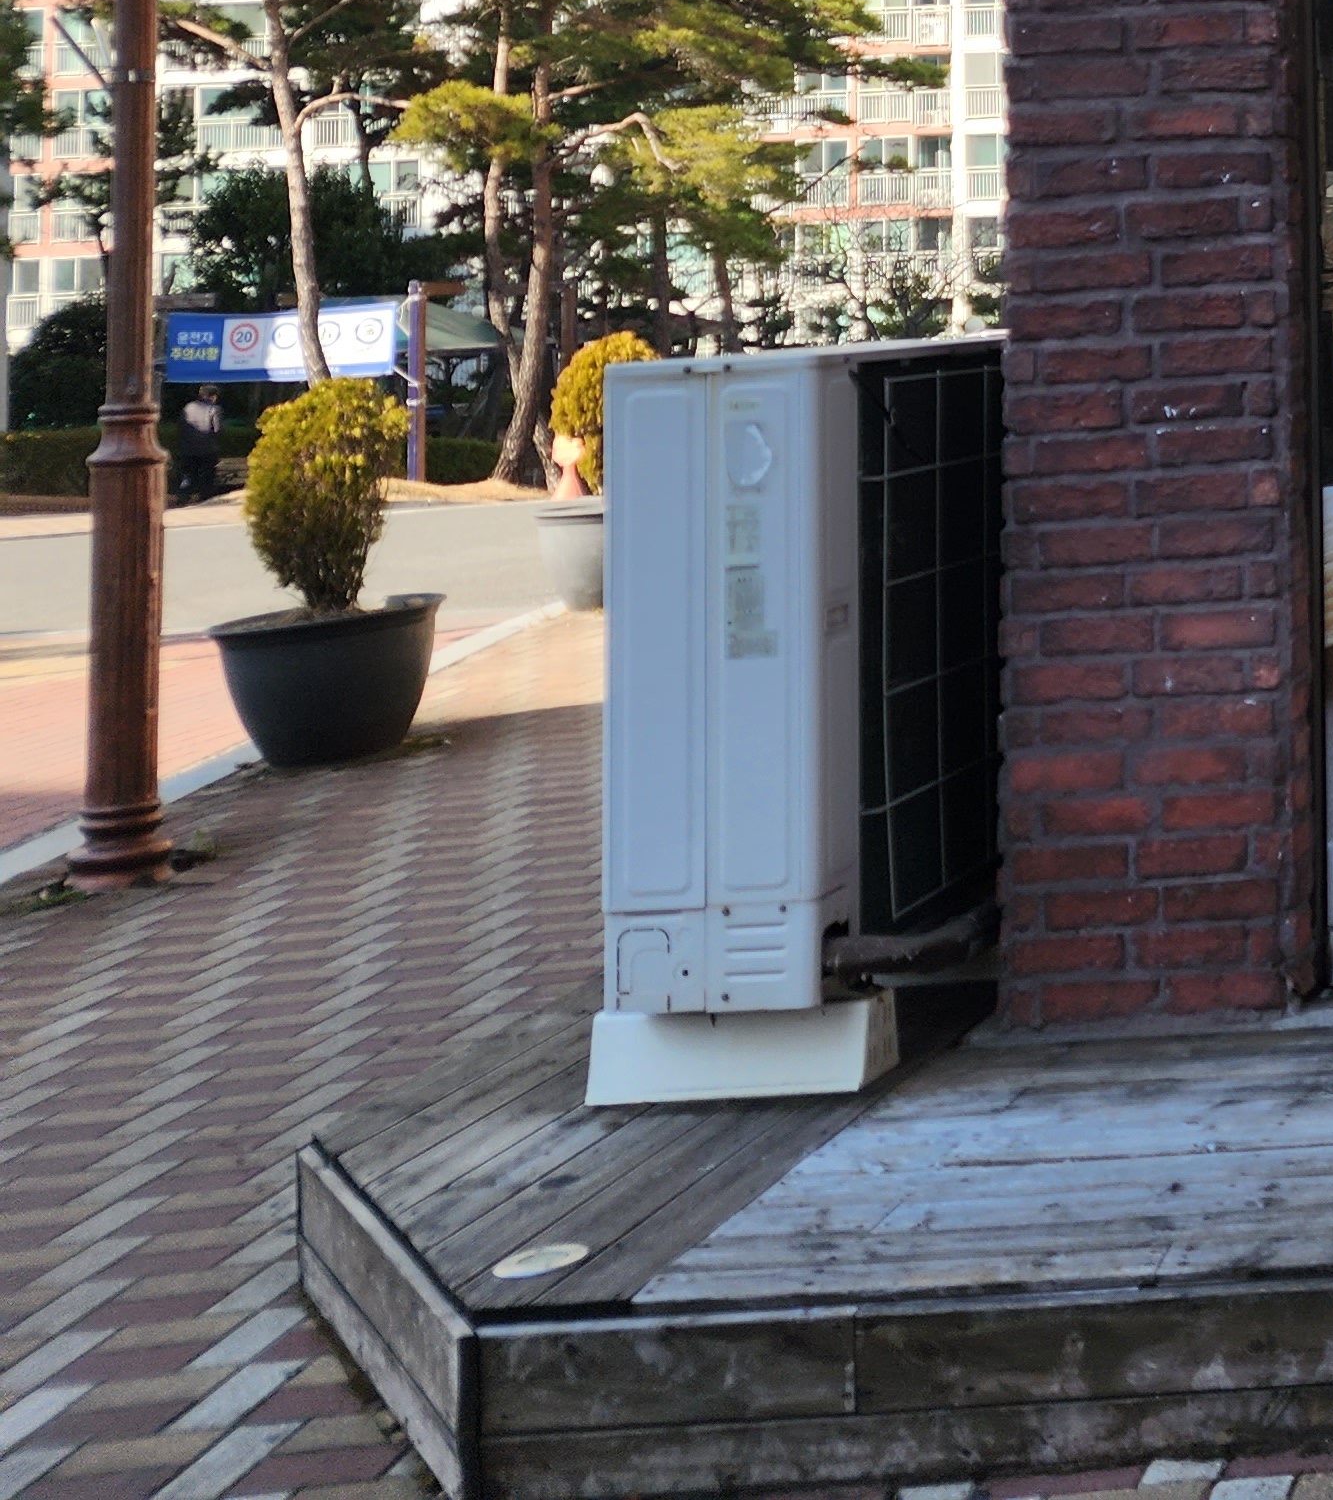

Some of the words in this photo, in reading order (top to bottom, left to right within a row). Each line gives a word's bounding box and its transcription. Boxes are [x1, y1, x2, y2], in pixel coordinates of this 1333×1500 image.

[176, 331, 214, 345] 운전자
[235, 331, 253, 344] 20
[170, 346, 219, 362] 주의사항
